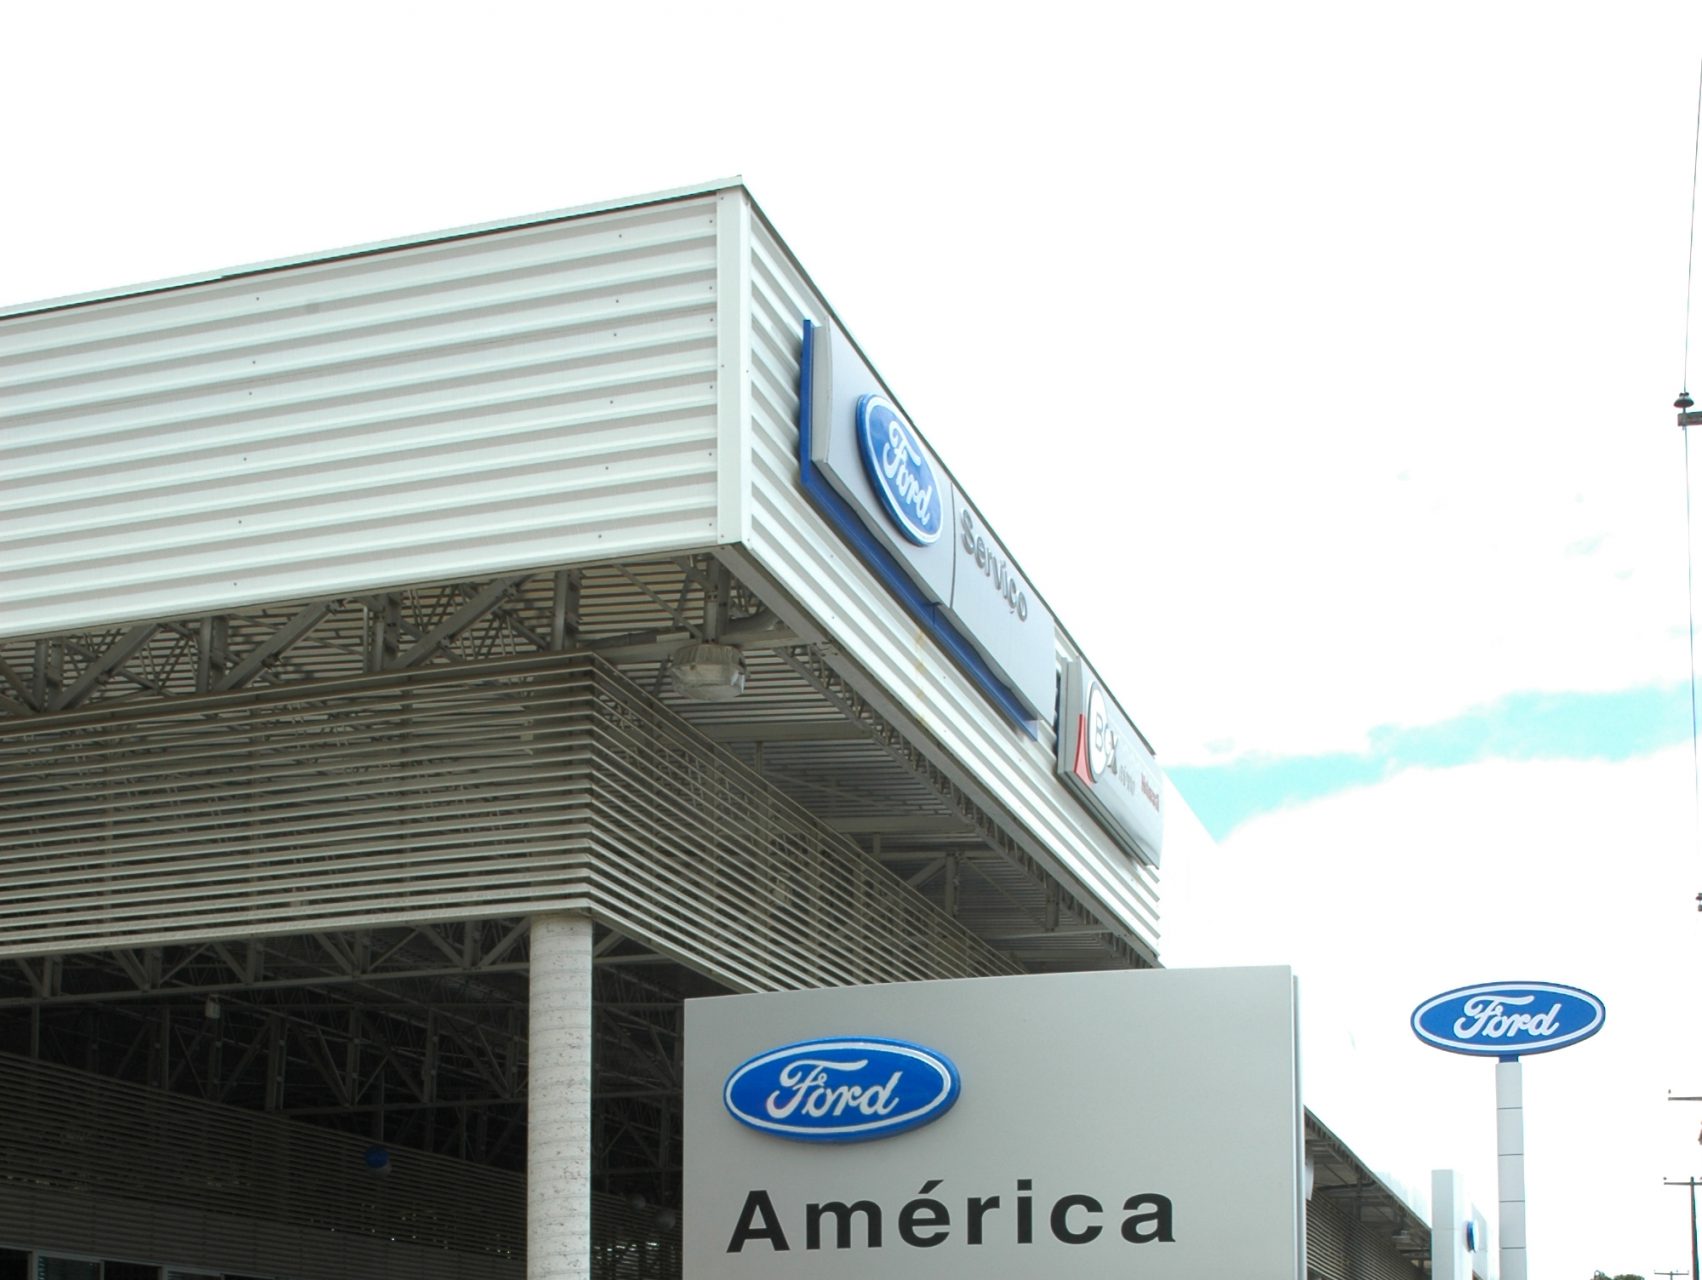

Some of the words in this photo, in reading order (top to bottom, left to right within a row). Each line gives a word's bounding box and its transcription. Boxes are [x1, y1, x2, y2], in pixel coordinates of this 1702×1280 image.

[882, 420, 933, 526] Ford
[960, 507, 1028, 622] Serviço
[1453, 995, 1562, 1039] Ford
[766, 1059, 903, 1119] Ford
[726, 1179, 1176, 1254] América
